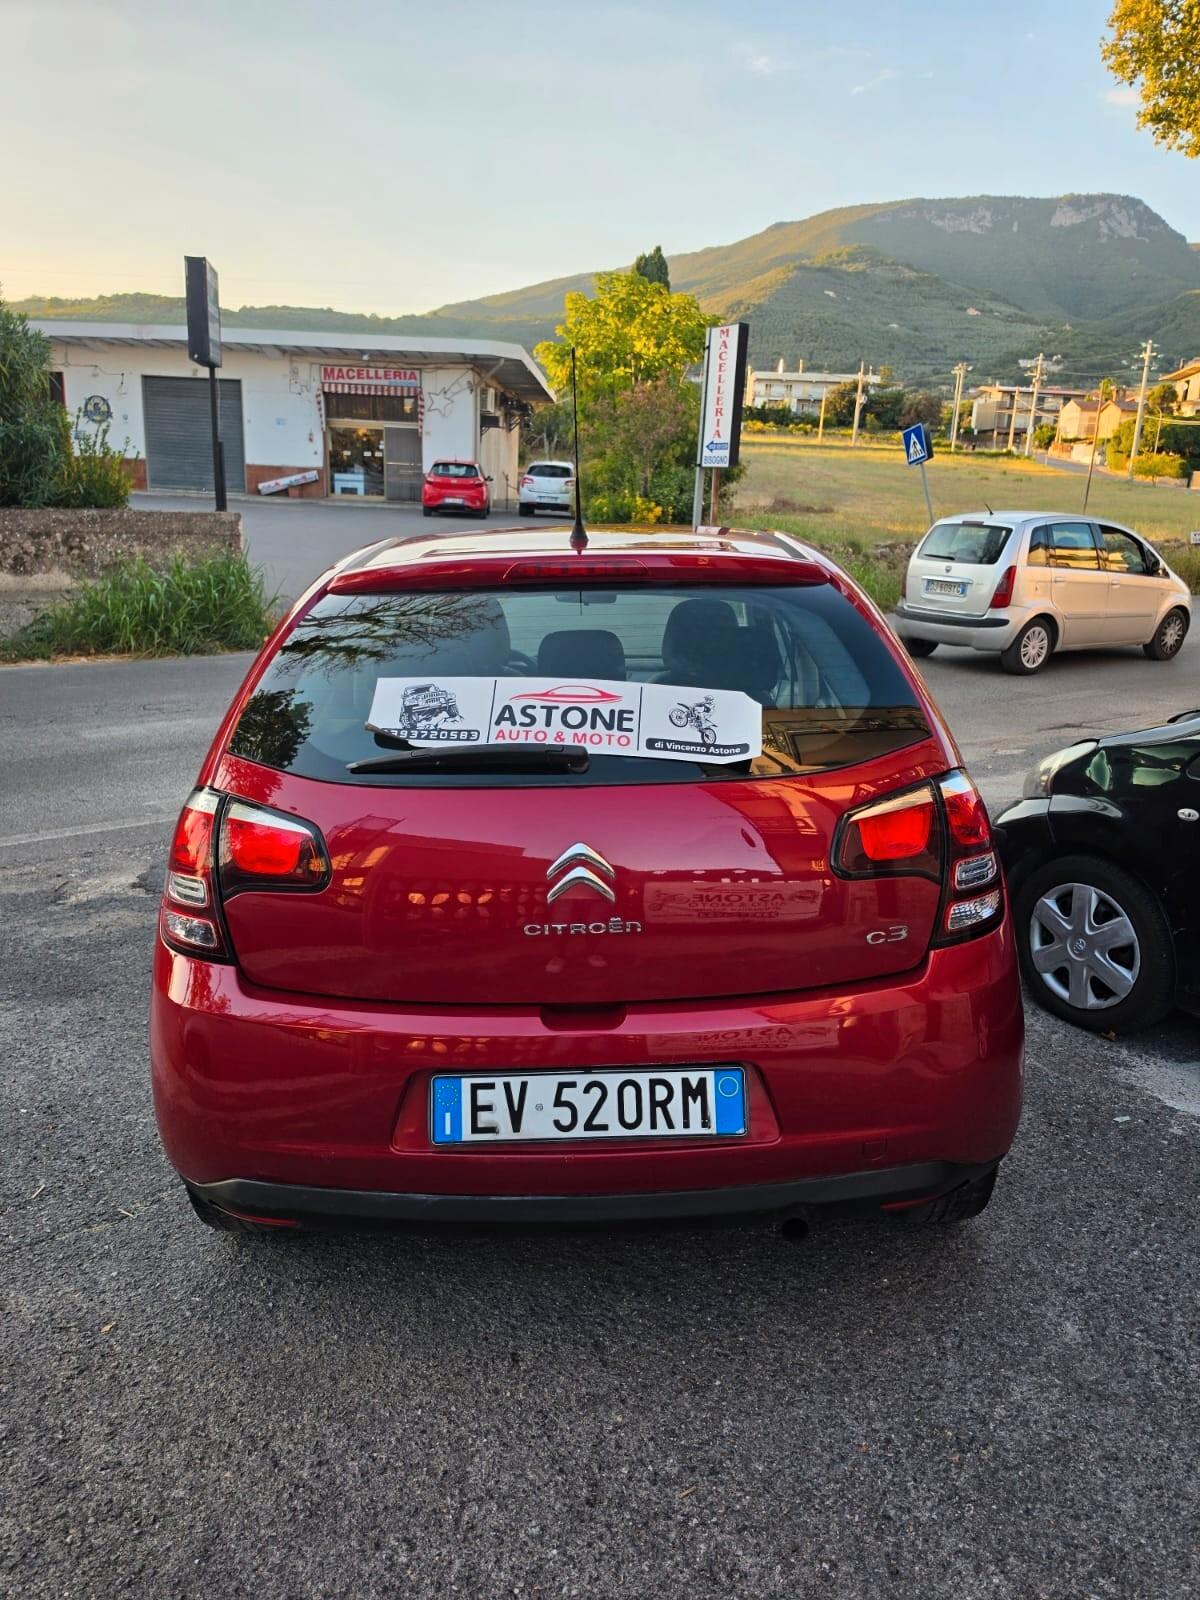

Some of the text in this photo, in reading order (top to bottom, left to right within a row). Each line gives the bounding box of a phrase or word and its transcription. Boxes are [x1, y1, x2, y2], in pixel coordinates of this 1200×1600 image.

[323, 367, 417, 380] MACELLERIA
[713, 328, 730, 439] MACELLERIA
[494, 704, 635, 733] ASTONE
[383, 729, 478, 740] 393720583
[495, 729, 631, 747] AUTO & MOTO
[654, 741, 741, 755] di Vincenzo Astone
[866, 925, 908, 945] C3
[470, 1077, 711, 1134] EV 520RM
